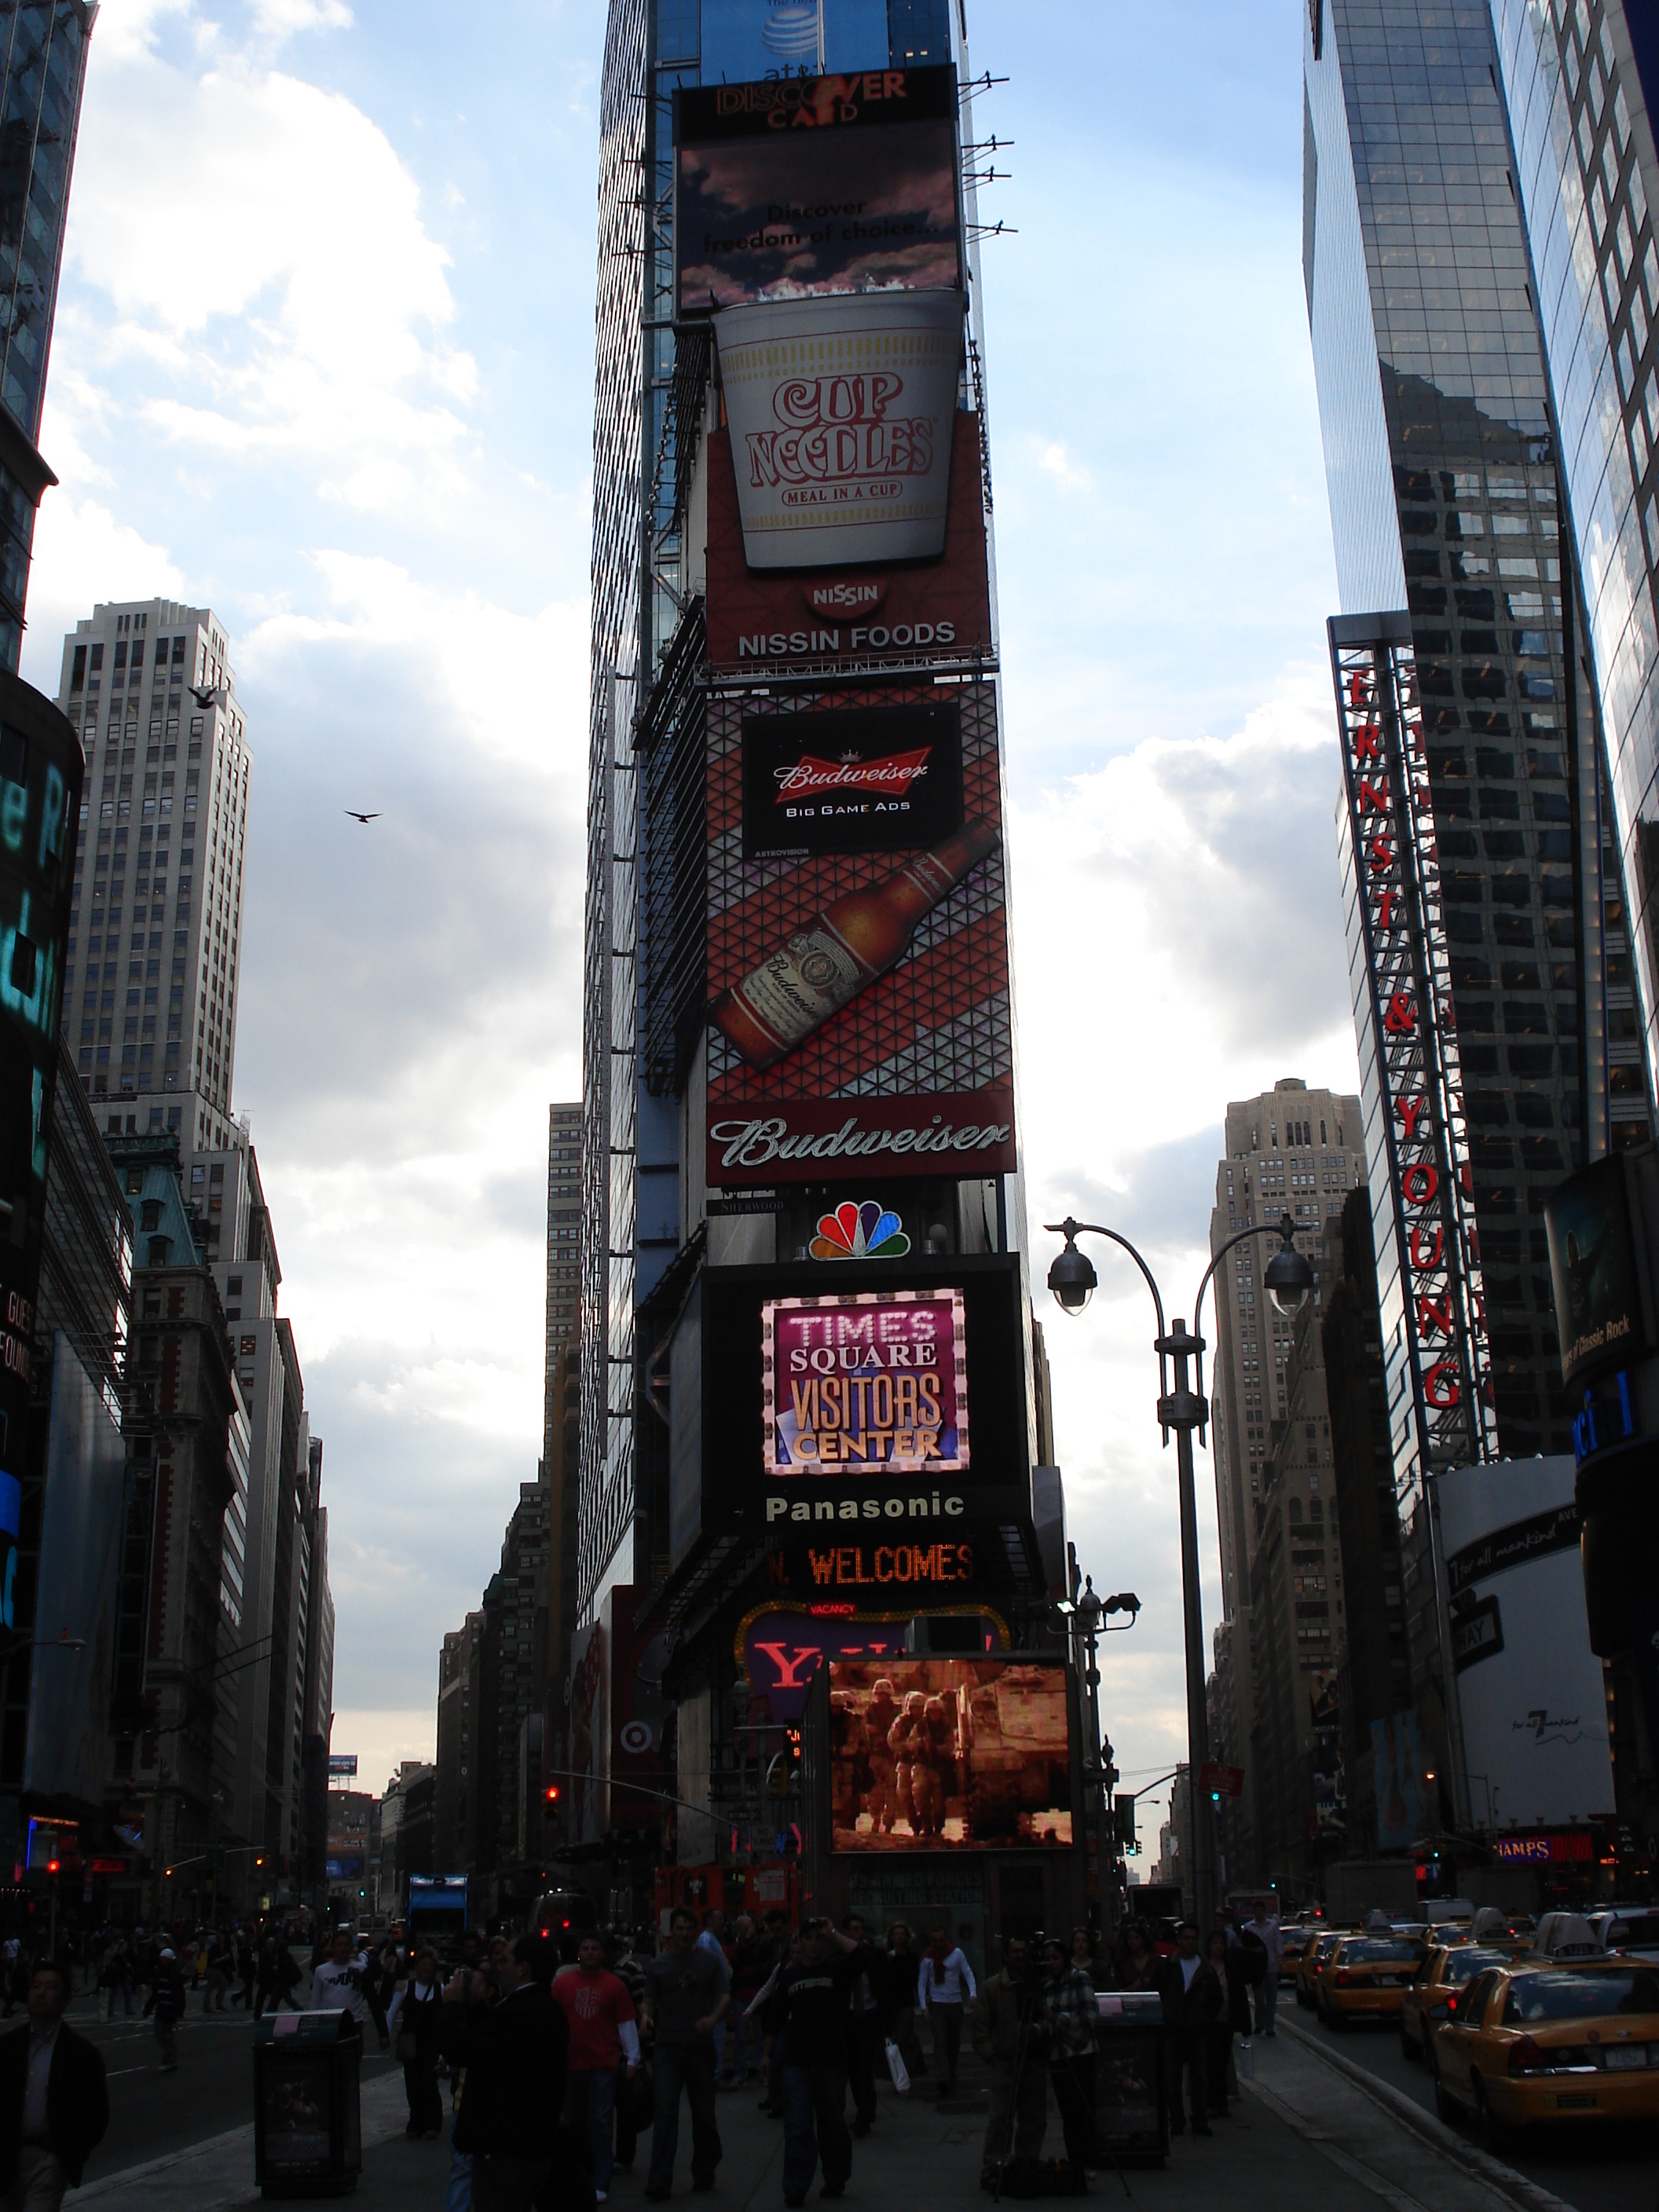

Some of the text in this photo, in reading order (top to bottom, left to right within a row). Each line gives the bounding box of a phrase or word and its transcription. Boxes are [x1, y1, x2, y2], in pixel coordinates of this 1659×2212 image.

[767, 101, 859, 130] CAD
[767, 200, 866, 222] Discover
[702, 229, 800, 252] freedom
[810, 225, 832, 244] of
[773, 372, 903, 430] CUP
[745, 416, 934, 488] NOODLES
[787, 483, 898, 504] MEAL IN A CUP
[813, 584, 878, 606] NISSIN
[739, 621, 956, 657] NISSIN FOODS
[773, 762, 928, 790] Budweiser
[754, 848, 809, 859] ASTROVISION
[1351, 670, 1459, 1408] ERNST & YOUNG
[709, 1114, 1012, 1168] Budweiser
[720, 1199, 784, 1212] SHERWOOD
[789, 1310, 936, 1347] TIMES
[1579, 1326, 1605, 1357] Classic
[1606, 1314, 1631, 1342] Rock
[789, 1342, 938, 1375] SQUARE
[790, 1372, 942, 1431] VISITORS
[792, 1430, 943, 1461] CENTER
[766, 1491, 965, 1522] Panasonic
[1459, 1558, 1474, 1580] for
[1477, 1545, 1492, 1565] all
[1496, 1523, 1557, 1558] mankind
[1557, 1507, 1579, 1523] AVE
[808, 1543, 974, 1585] WELCOMES
[811, 1603, 855, 1615] VACANCY
[1528, 1709, 1547, 1738] 7
[753, 1837, 775, 1846] TURNS
[930, 1888, 983, 1904] STATION
